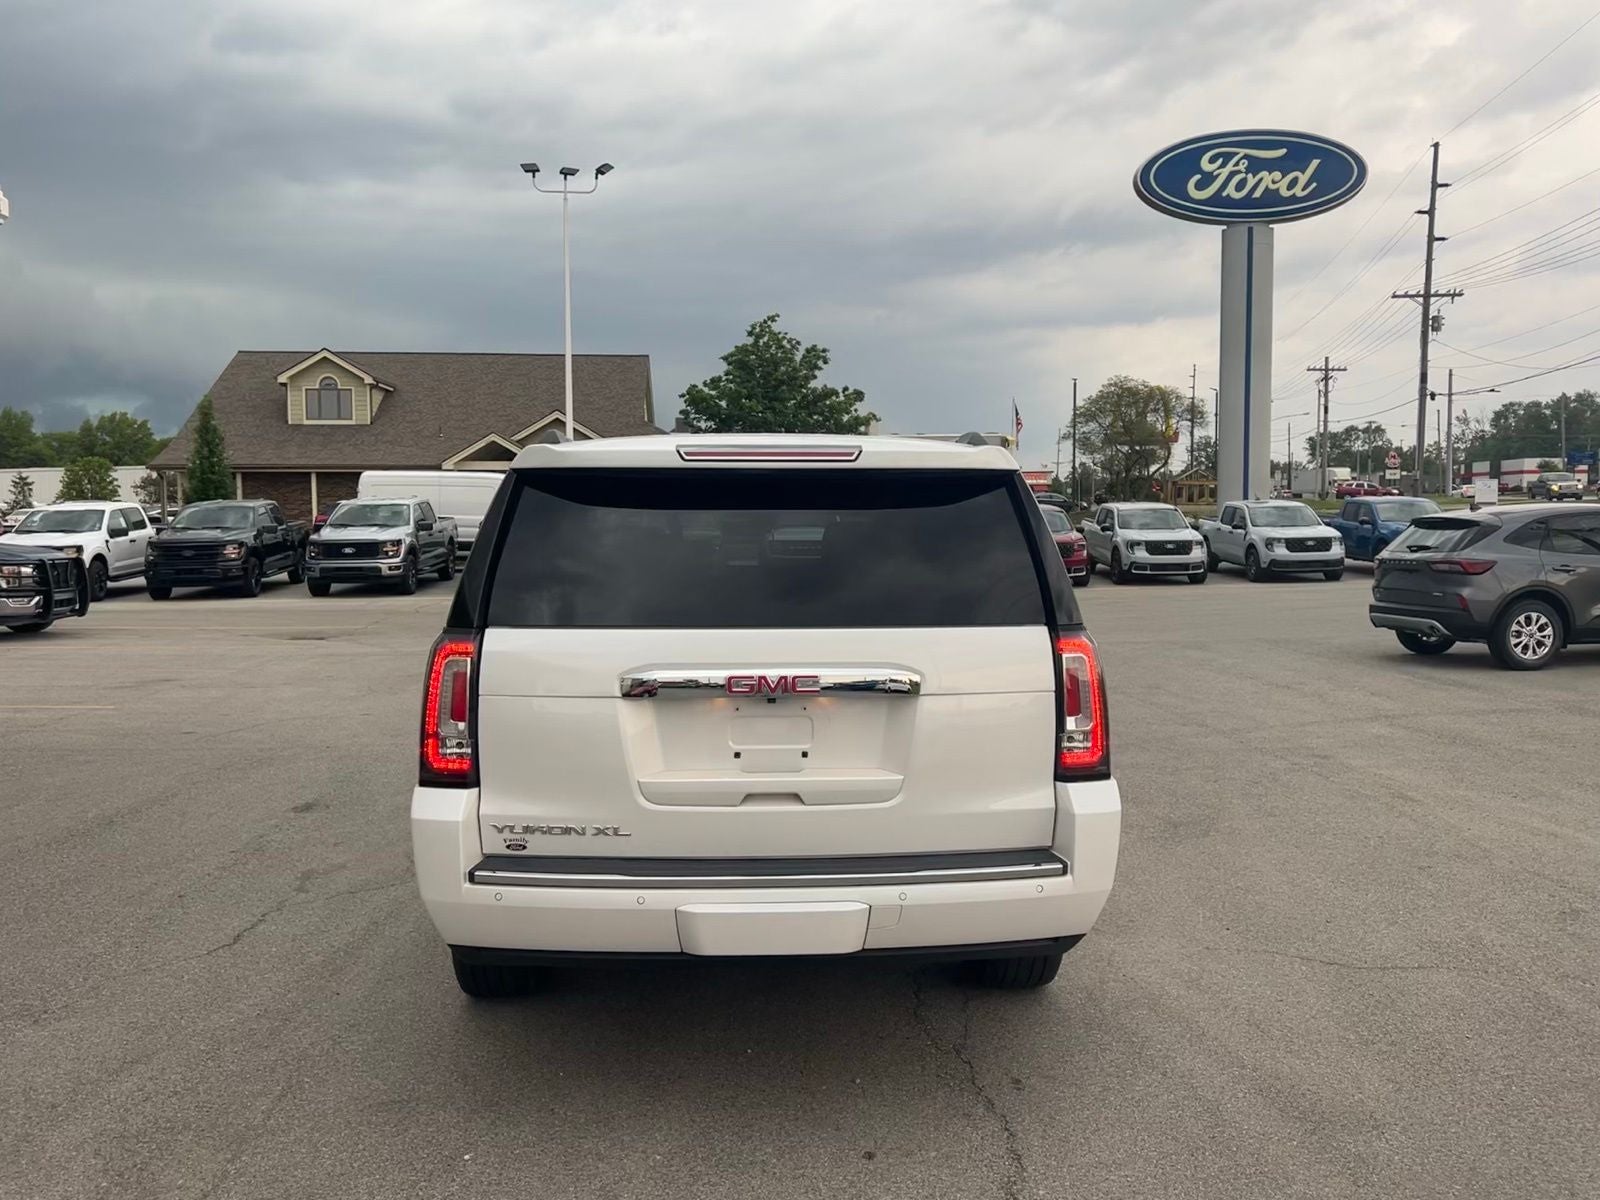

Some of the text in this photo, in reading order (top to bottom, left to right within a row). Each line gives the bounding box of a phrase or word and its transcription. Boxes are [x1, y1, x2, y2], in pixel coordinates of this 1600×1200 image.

[1186, 147, 1321, 200] Ford
[725, 674, 821, 695] GMC
[488, 822, 632, 837] YUKON XL
